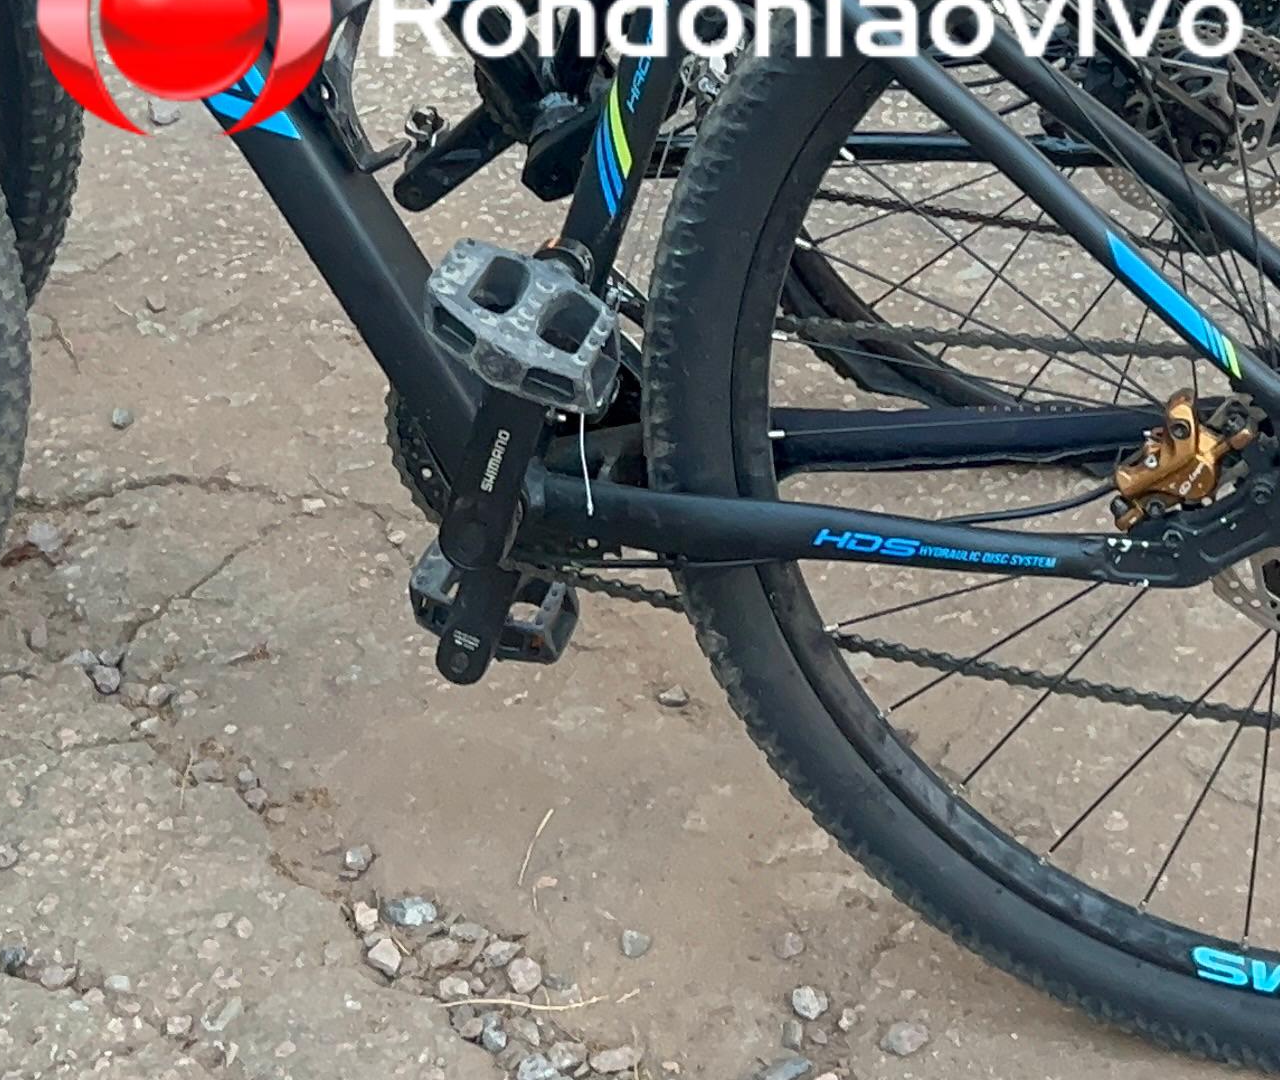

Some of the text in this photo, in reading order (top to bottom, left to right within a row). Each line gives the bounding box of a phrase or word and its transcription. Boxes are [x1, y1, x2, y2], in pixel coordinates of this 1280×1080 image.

[480, 429, 511, 493] SHIMANO
[813, 528, 1057, 569] HDS HYDRAULIC DISC SYSTEM
